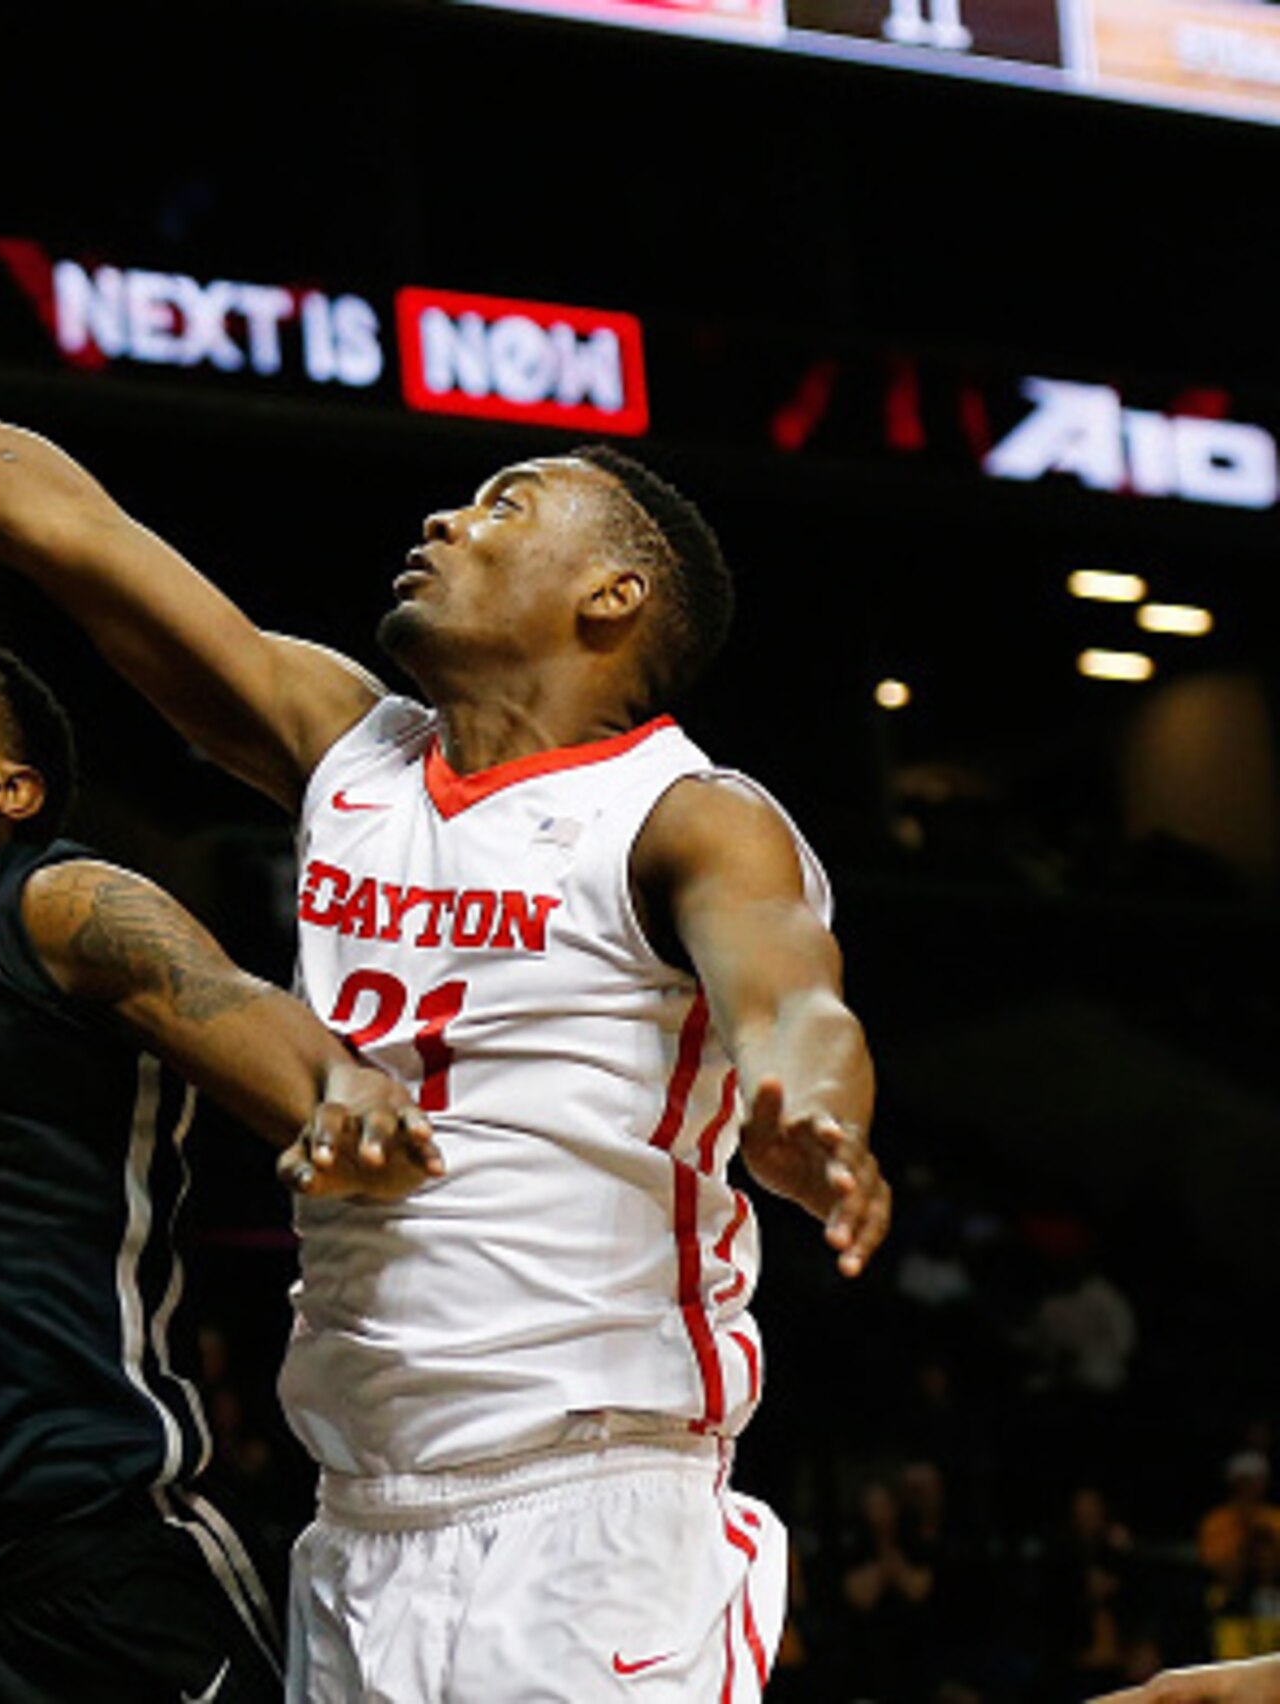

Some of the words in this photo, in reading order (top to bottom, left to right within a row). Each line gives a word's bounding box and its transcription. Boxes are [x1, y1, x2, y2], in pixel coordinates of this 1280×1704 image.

[53, 260, 294, 375] NEXT
[302, 292, 383, 387] IS
[420, 308, 624, 414] NOW
[298, 860, 562, 952] DAYTON
[328, 969, 468, 1112] 21
